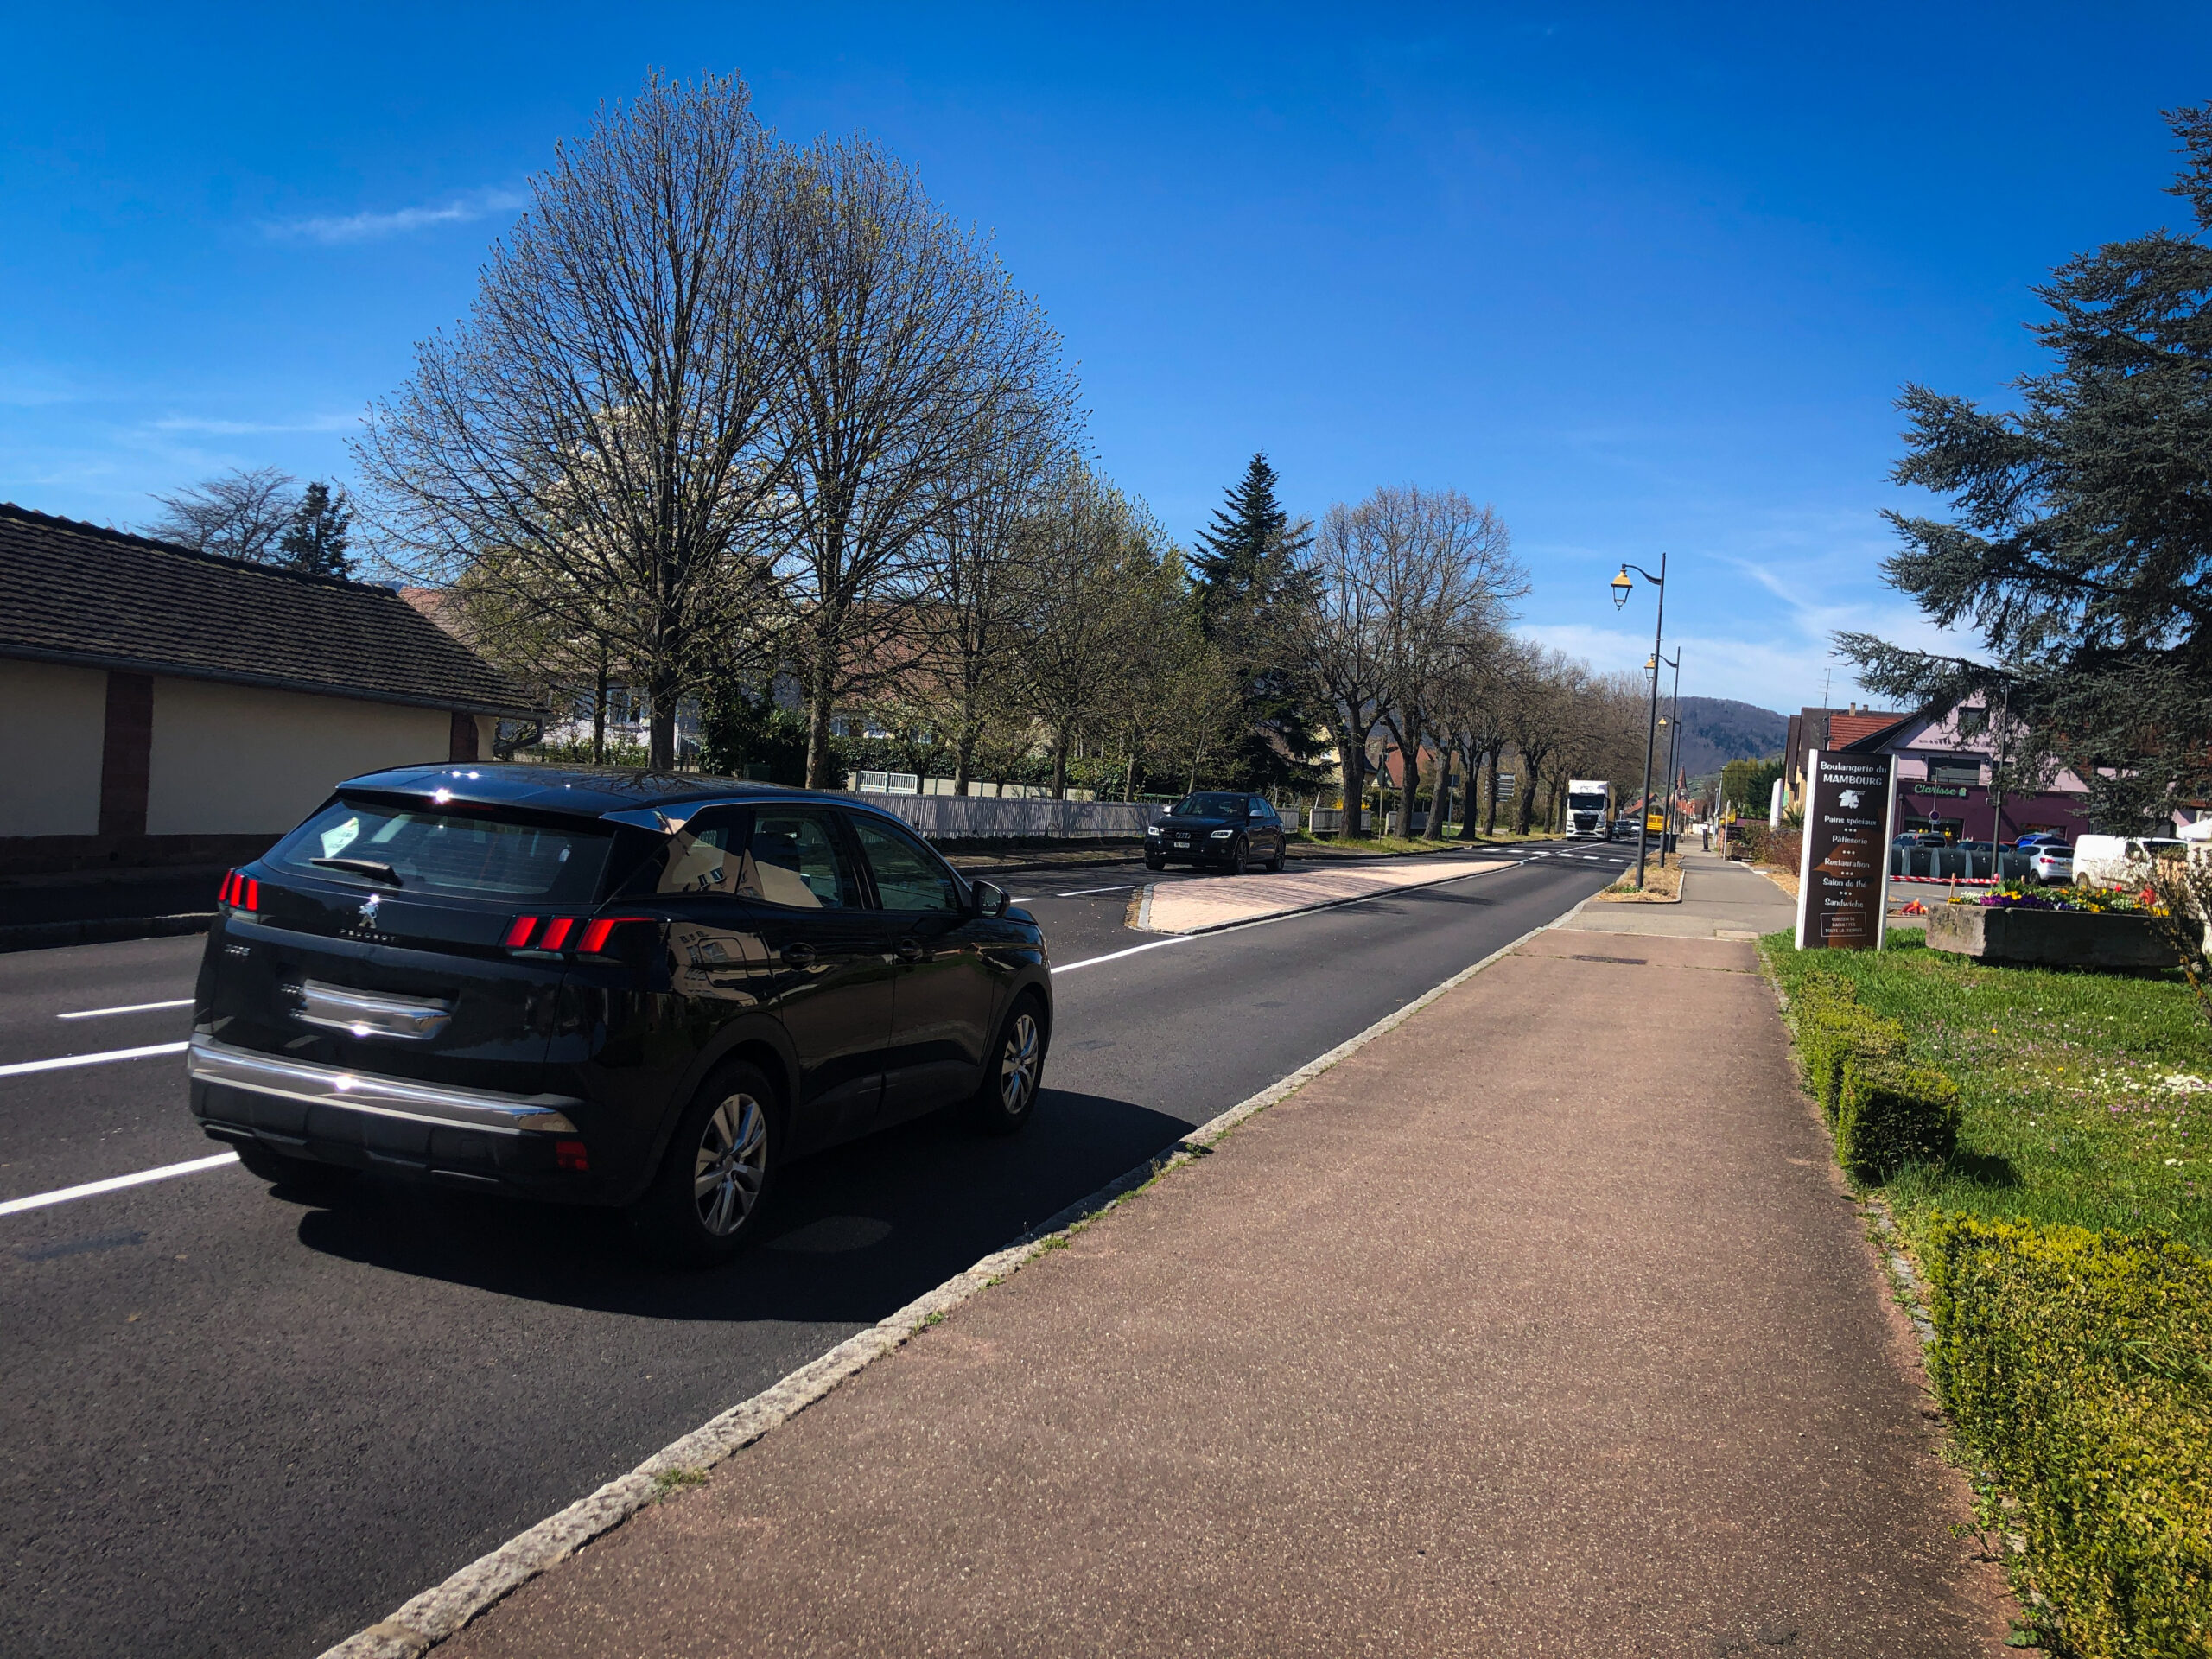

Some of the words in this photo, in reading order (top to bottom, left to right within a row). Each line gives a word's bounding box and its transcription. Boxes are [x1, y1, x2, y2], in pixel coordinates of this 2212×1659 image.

[1821, 761, 1874, 773] Boulangerie
[1823, 774, 1882, 785] MAMBOURG
[1914, 783, 1956, 795] Clarisse
[1824, 815, 1845, 823] Pains
[1832, 835, 1868, 844] Pâtisserie
[1824, 857, 1870, 868] Restauration
[1822, 877, 1844, 887] Salon
